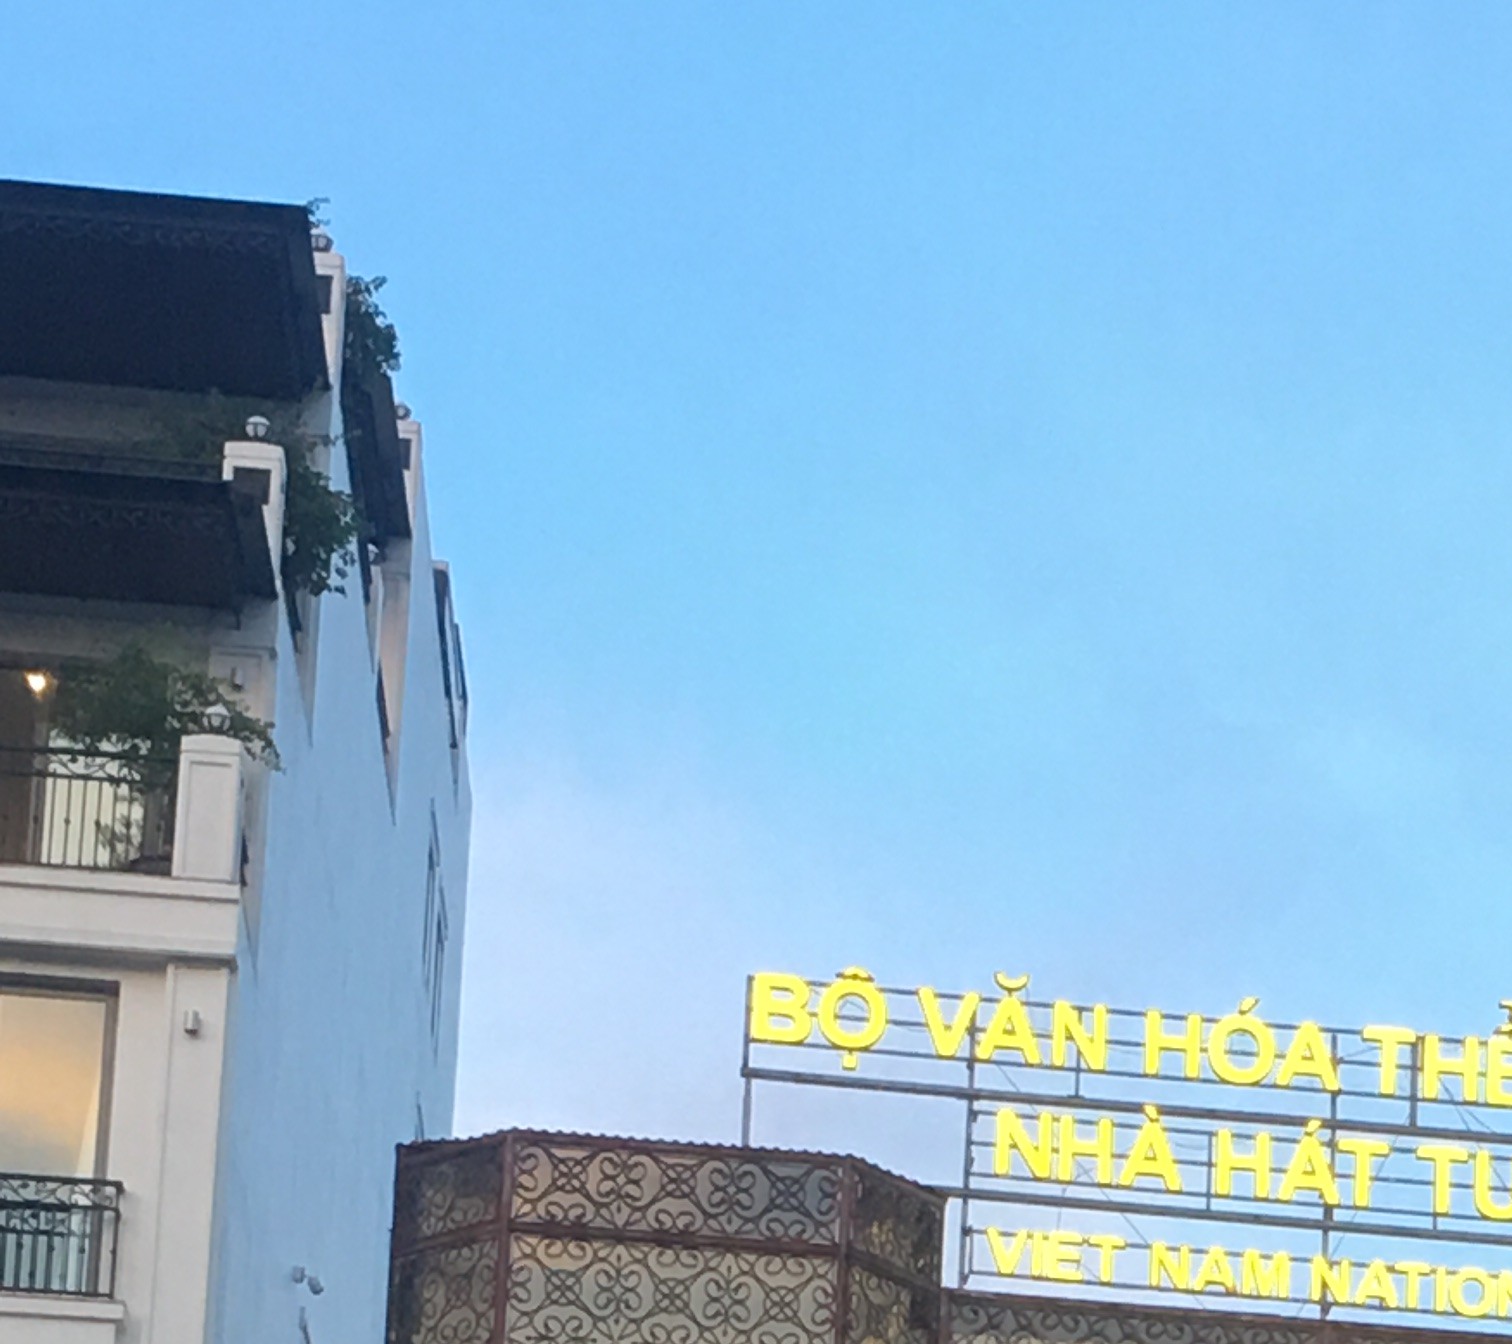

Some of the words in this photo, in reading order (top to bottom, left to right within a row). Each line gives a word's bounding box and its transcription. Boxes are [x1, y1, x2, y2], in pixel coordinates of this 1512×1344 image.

[751, 967, 888, 1070] BỘ
[918, 972, 1107, 1071] VĂN
[1144, 996, 1341, 1092] HÓA
[993, 1104, 1182, 1193] NHÀ
[1214, 1119, 1390, 1208] HÁT
[986, 1226, 1126, 1282] VIET
[1148, 1241, 1290, 1299] NAM
